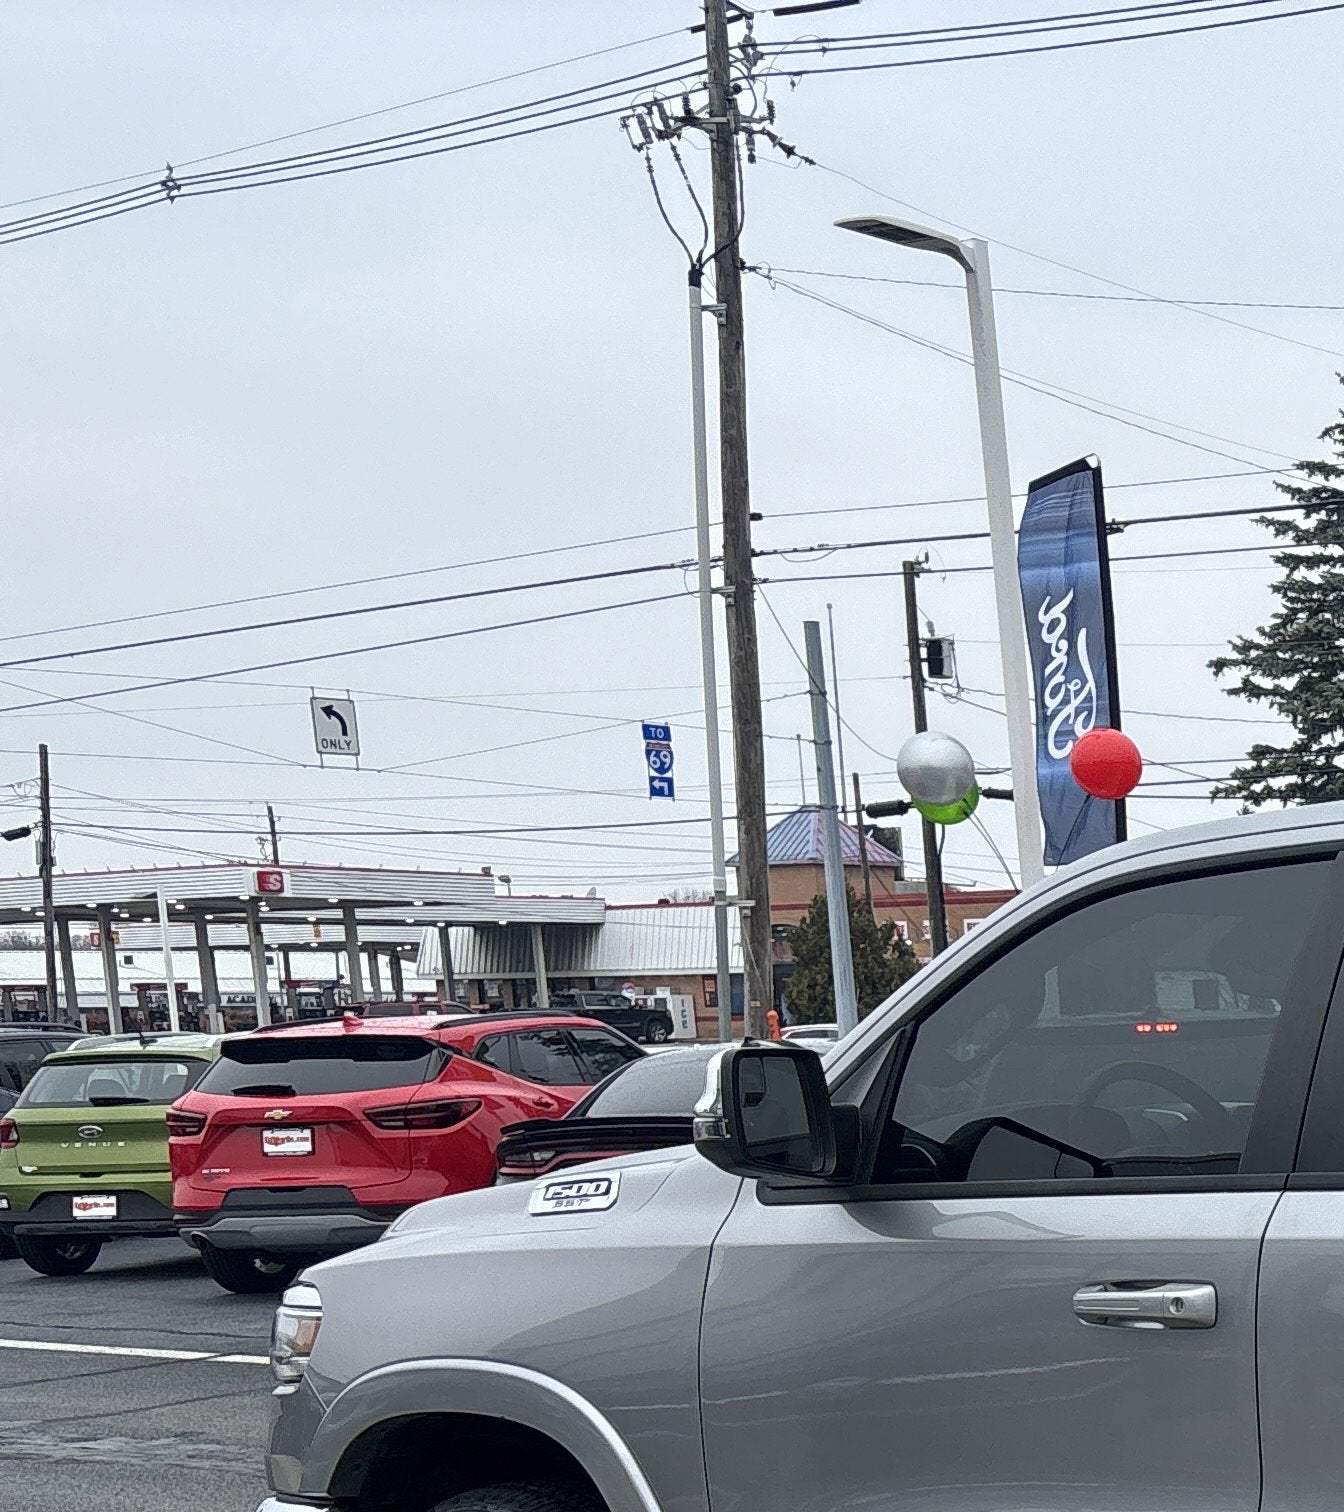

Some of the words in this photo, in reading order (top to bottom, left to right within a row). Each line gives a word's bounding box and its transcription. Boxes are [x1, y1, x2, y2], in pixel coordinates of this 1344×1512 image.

[648, 727, 665, 739] TO
[321, 738, 352, 751] ONLY
[649, 750, 671, 769] 69
[680, 999, 689, 1029] ICE
[543, 1179, 611, 1200] 1500
